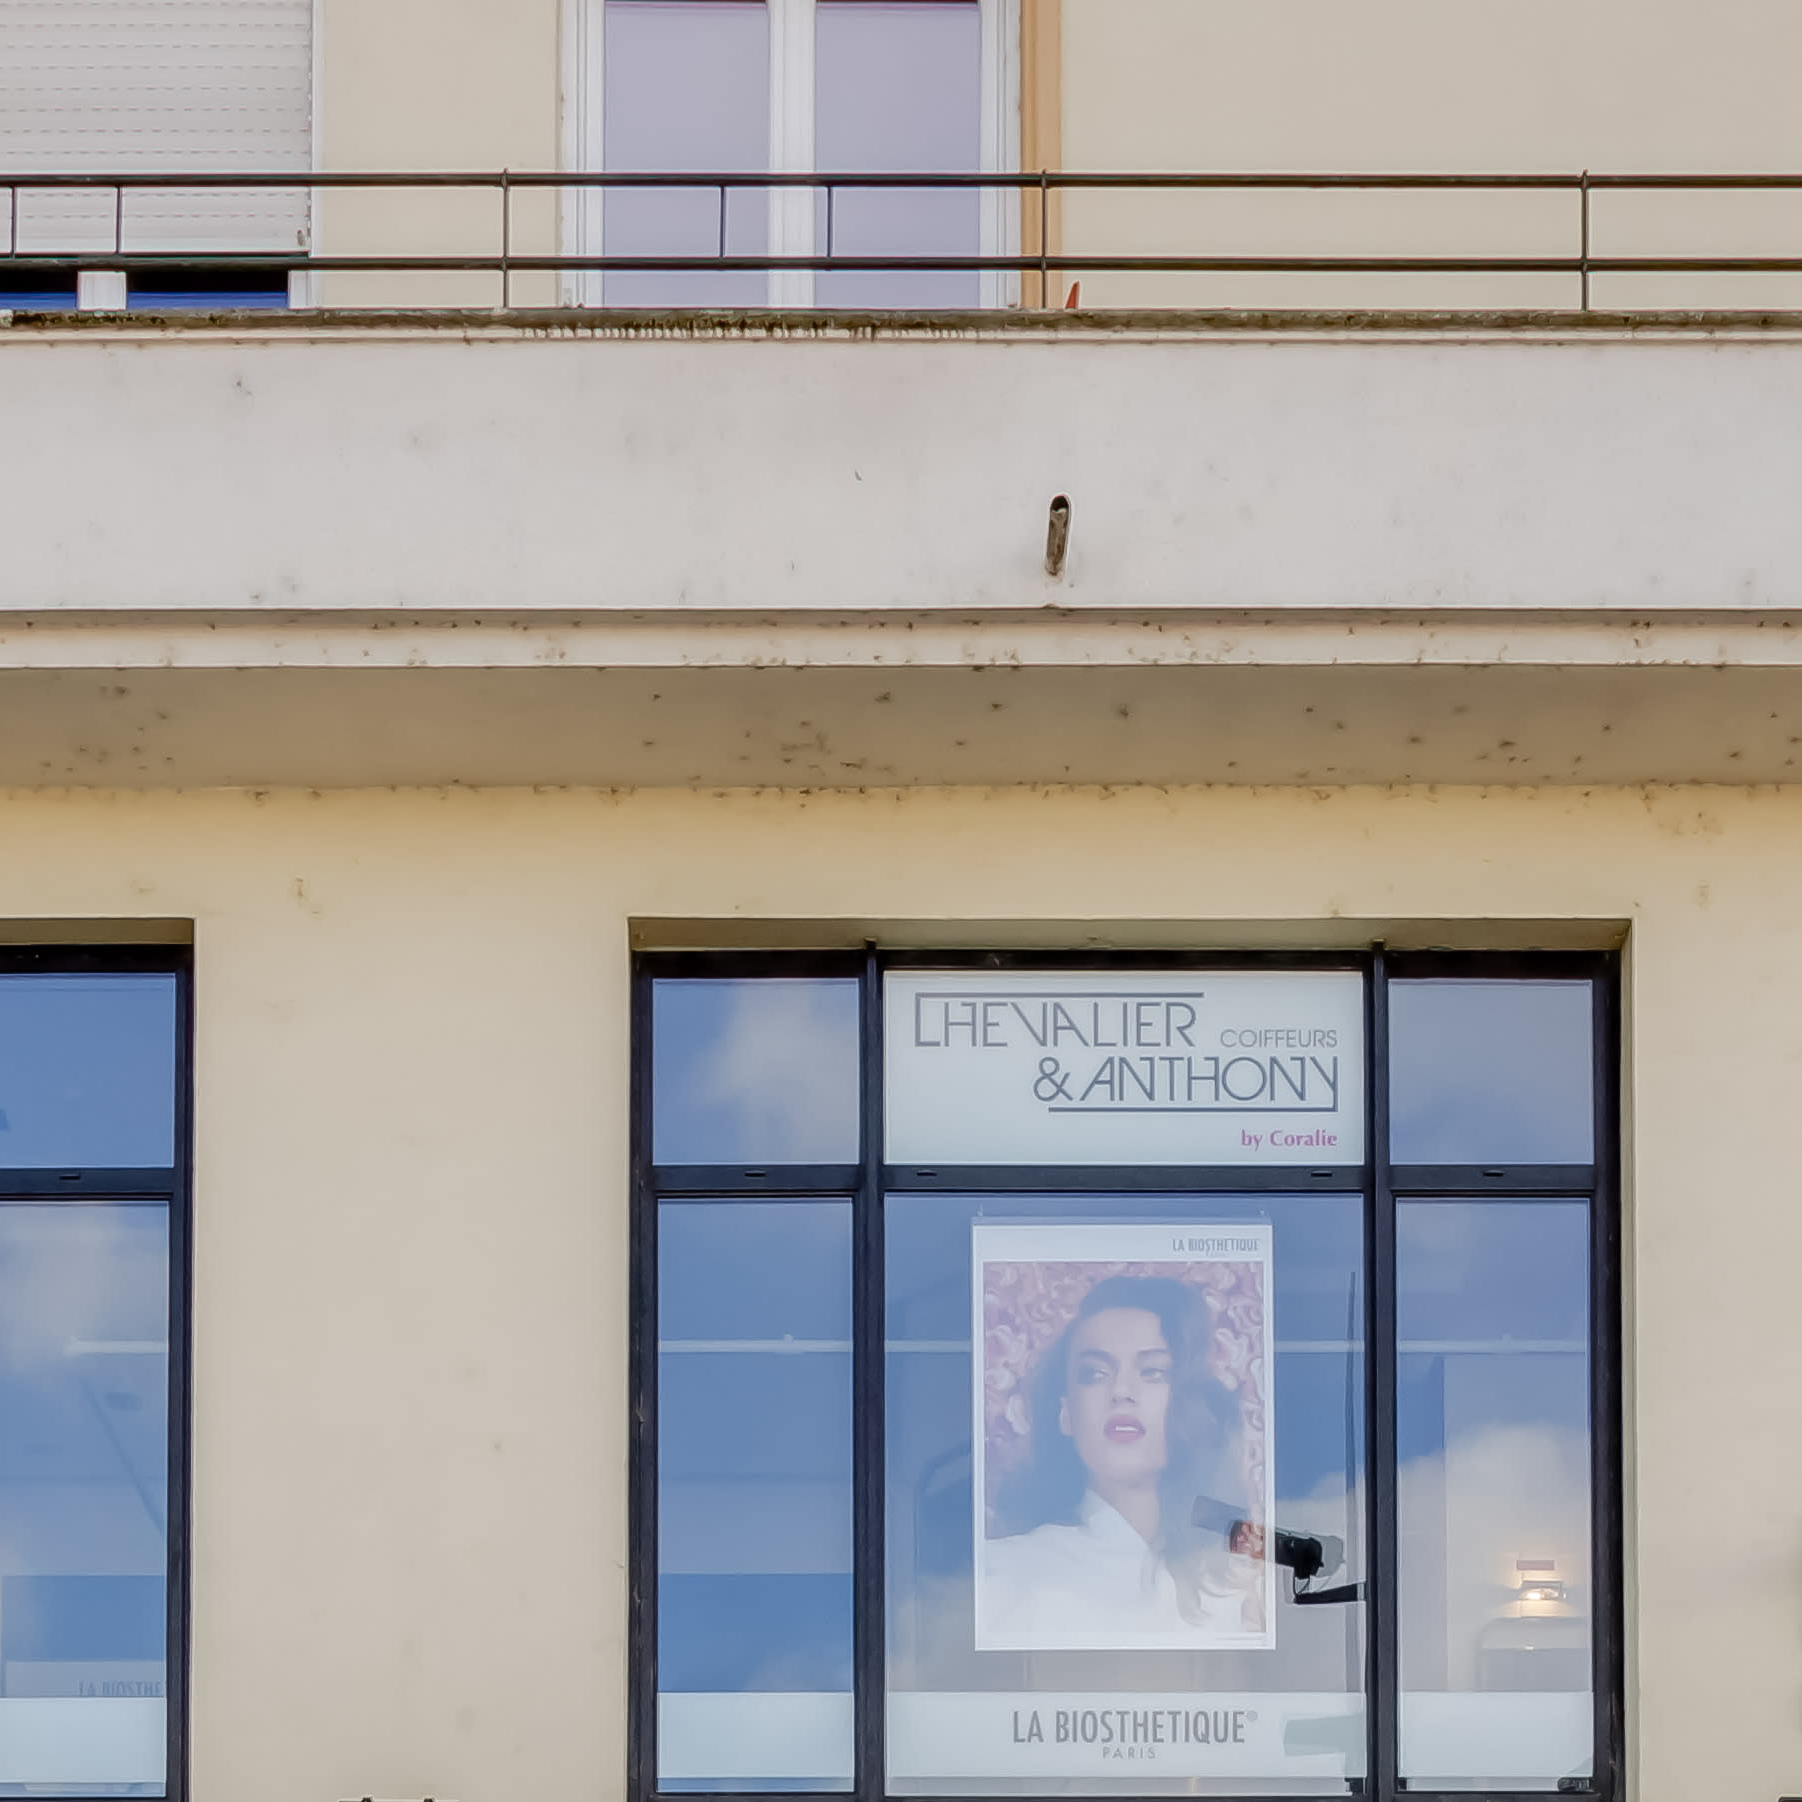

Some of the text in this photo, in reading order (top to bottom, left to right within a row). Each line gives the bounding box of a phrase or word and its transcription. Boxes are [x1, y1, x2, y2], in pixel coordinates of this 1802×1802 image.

[914, 992, 1339, 1049] CHEVALIER COIFFEURS
[1079, 1056, 1339, 1112] ANTHONY
[1240, 1129, 1338, 1151] by Coralie
[1172, 1238, 1185, 1252] LA
[1012, 1710, 1045, 1744] LA
[1102, 1746, 1157, 1760] PARIS
